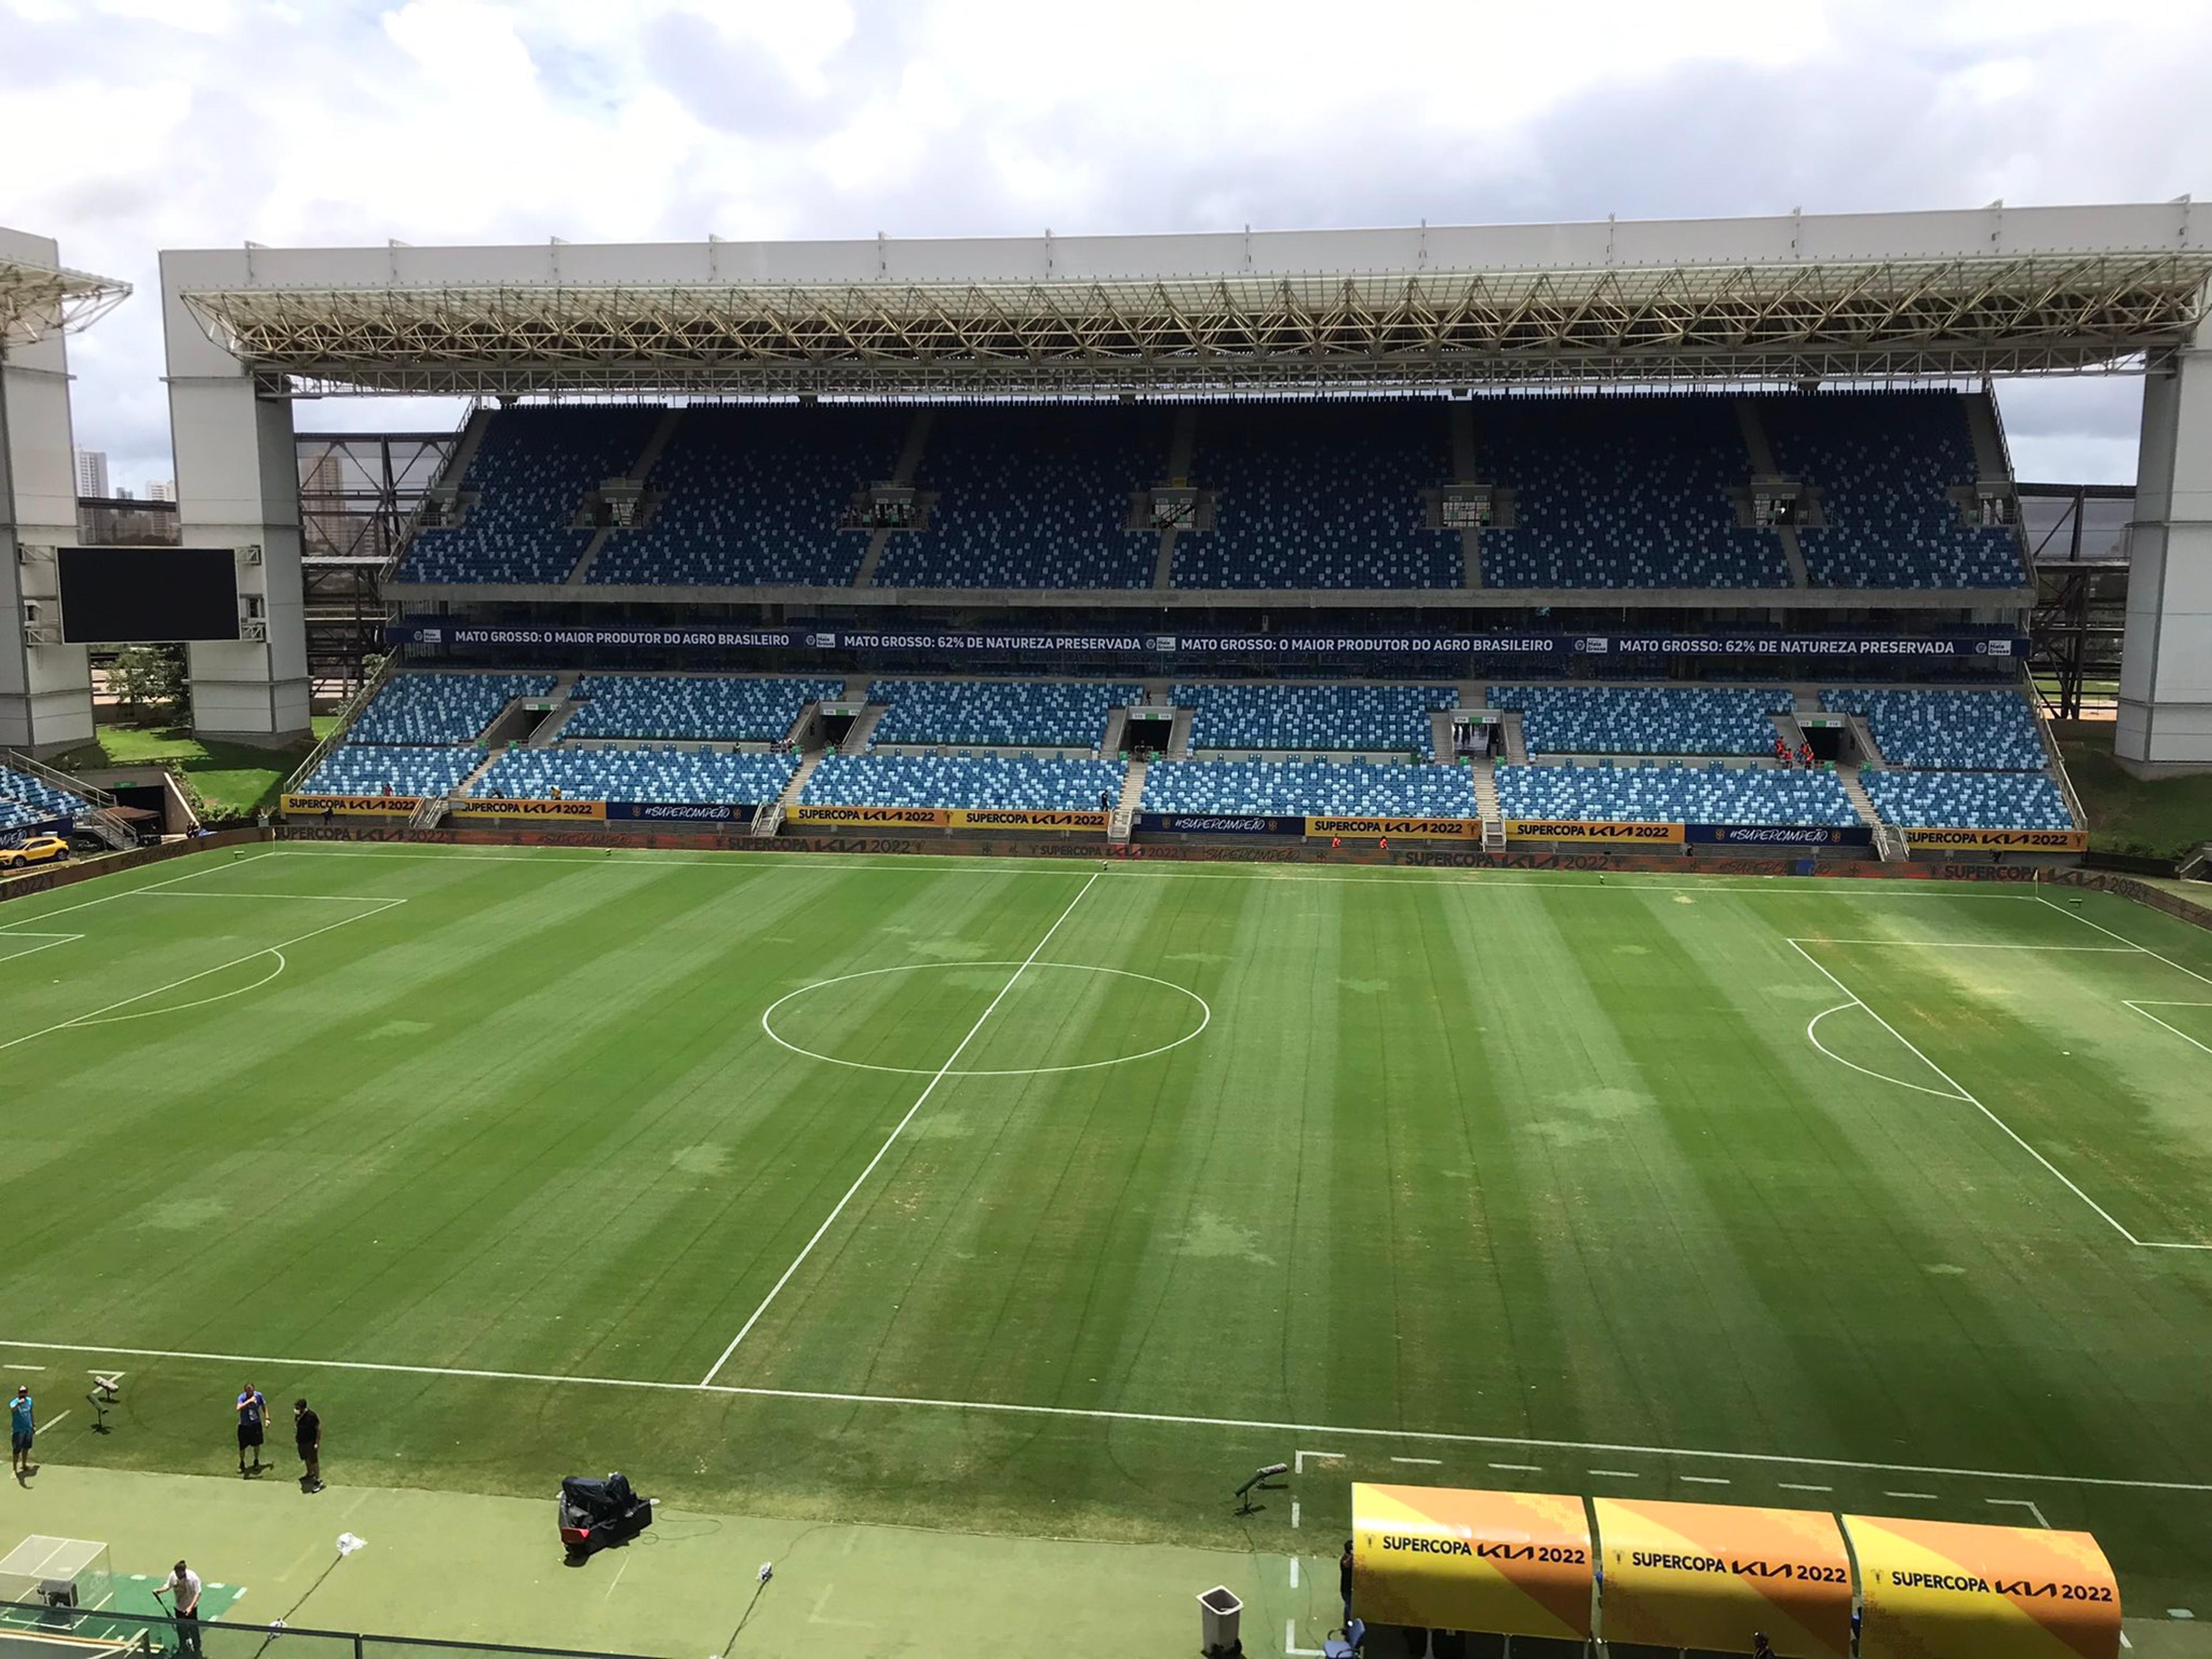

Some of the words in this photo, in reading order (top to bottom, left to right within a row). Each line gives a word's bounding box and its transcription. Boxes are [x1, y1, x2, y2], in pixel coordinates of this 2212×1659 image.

[456, 631, 488, 642] MATO
[491, 631, 542, 643] GROSSO:
[544, 632, 553, 643] O
[555, 632, 594, 643] MAIOR
[596, 633, 661, 644] PRODUTOR
[664, 634, 680, 644] DO
[683, 634, 715, 645] AGRO
[718, 634, 789, 646] BRASILEIRO
[844, 636, 880, 647] MATO
[881, 636, 935, 648] GROSSO:
[938, 637, 964, 648] 62%
[967, 637, 983, 649] DE
[986, 637, 1054, 649] NATUREZA
[1056, 638, 1141, 650] PRESERVADA
[1181, 639, 1217, 650] MATO
[1221, 639, 1277, 650] GROSSO:
[1279, 639, 1288, 650] O
[1292, 639, 1334, 650] MAIOR
[1338, 639, 1409, 651] PRODUTOR
[1412, 639, 1431, 651] DO
[1433, 639, 1471, 651] AGRO
[1474, 639, 1553, 652] BRASILEIRO
[1619, 640, 1658, 652] MATO
[1662, 640, 1722, 652] GROSSO:
[1726, 641, 1755, 652] 62%
[1759, 641, 1777, 652] DE
[1781, 641, 1857, 653] NATUREZA
[1861, 642, 1955, 654] PRESERVADA
[289, 798, 347, 810] SUPERCOPA
[388, 801, 415, 810] 2022
[563, 805, 592, 814] 2022
[645, 806, 730, 819] #SUPERCAMPEÃO
[798, 809, 860, 820] SUPERCOPA
[905, 812, 934, 821] 2022
[967, 813, 1028, 824] SUPERCOPA
[1074, 816, 1104, 825] 2022
[1175, 817, 1266, 831] #SUPERCAMPEÃO
[1315, 820, 1381, 832] SUPERCOPA
[1430, 823, 1463, 834] 2022
[1517, 824, 1586, 836] SUPERCOPA
[1635, 827, 1668, 838] 2022
[1730, 828, 1828, 842] #SUPERCAMPEÃO
[2031, 835, 2068, 846] 2022
[1383, 1536, 1471, 1556] SUPERCOPA
[1539, 1547, 1585, 1565] 2022
[1633, 1552, 1726, 1573] SUPERCOPA
[1797, 1565, 1847, 1583] 2022
[1892, 1571, 1990, 1593] SUPERCOPA
[2062, 1585, 2112, 1602] 2022
